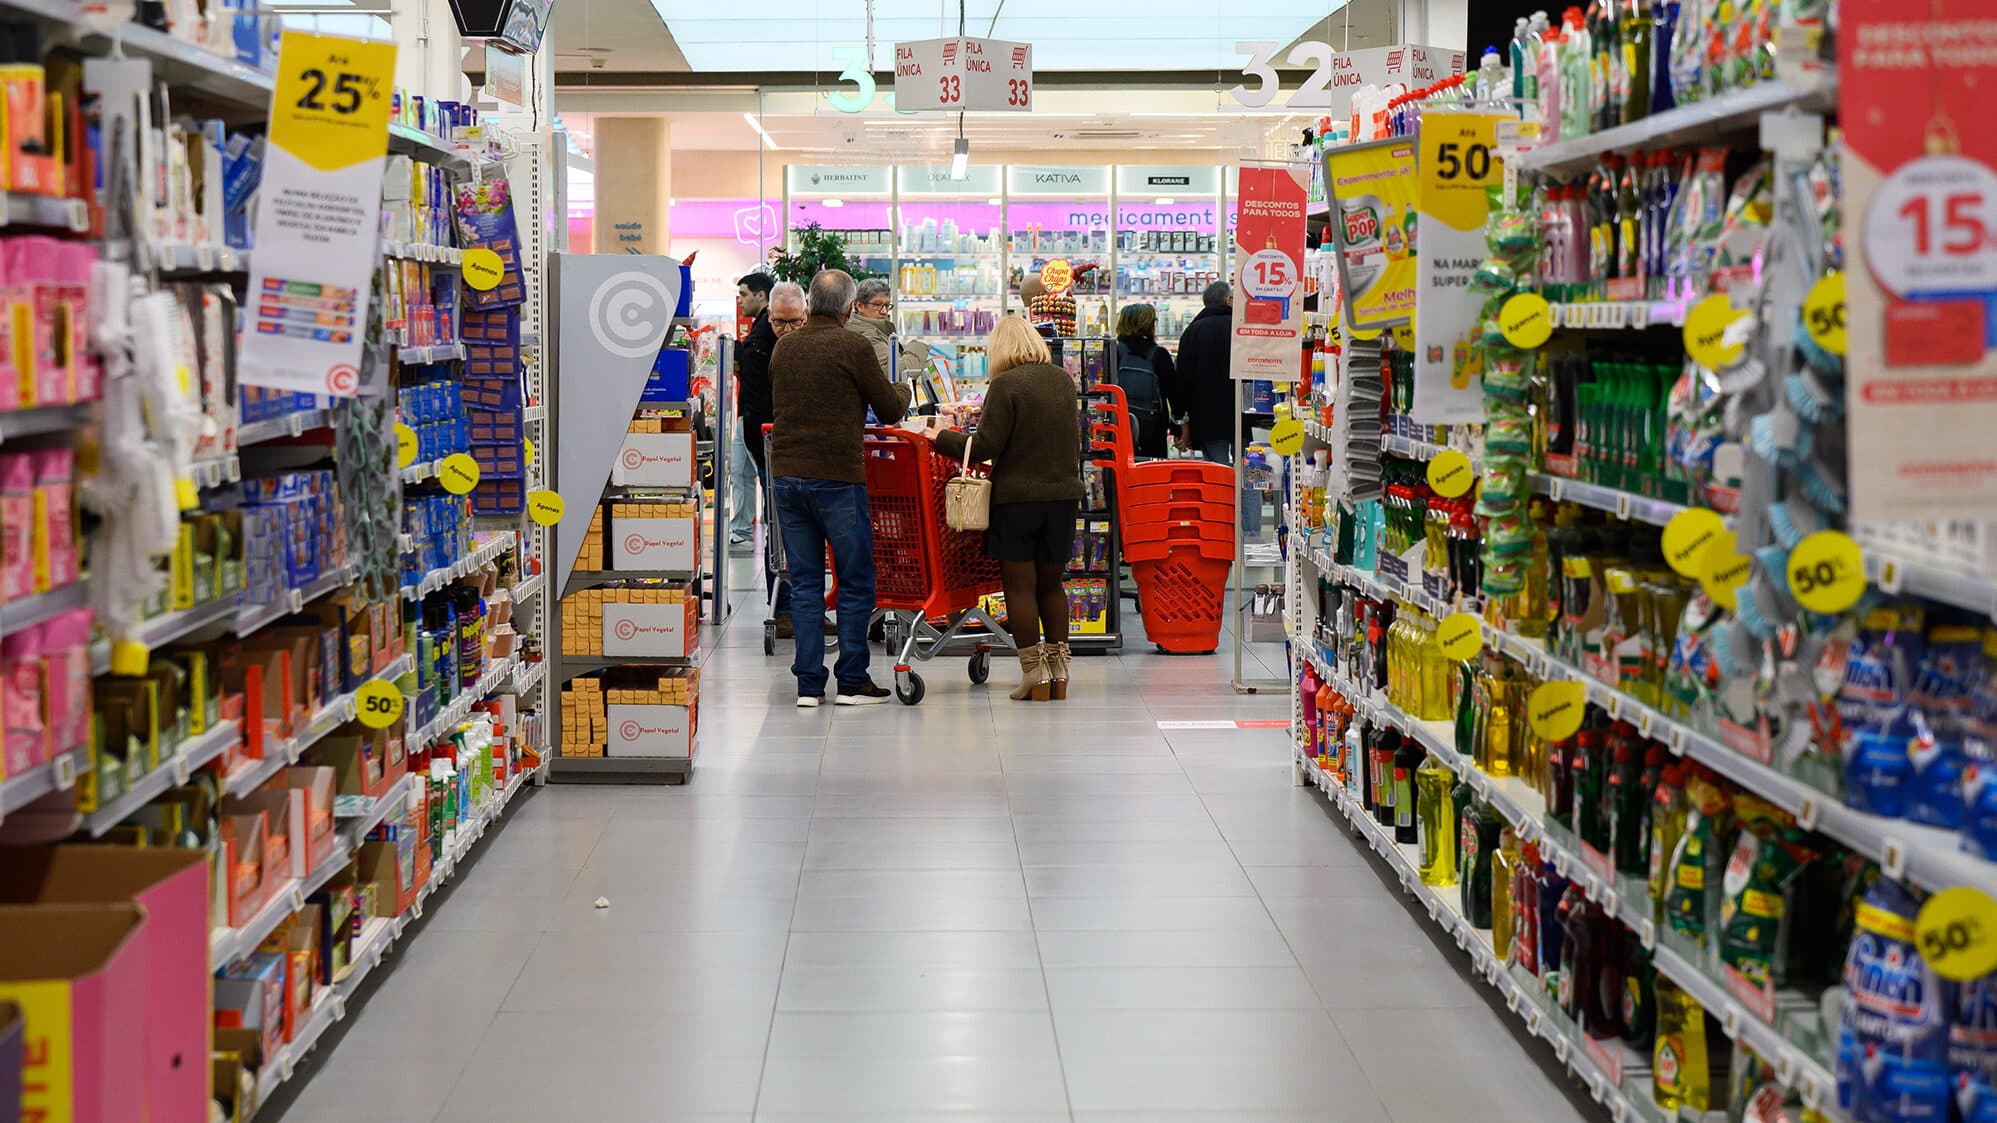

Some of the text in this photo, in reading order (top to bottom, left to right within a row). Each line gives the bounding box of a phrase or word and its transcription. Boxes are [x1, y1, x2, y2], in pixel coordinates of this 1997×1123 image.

[896, 48, 913, 60] FILA
[966, 42, 983, 55] FILA
[1412, 49, 1427, 62] FILA
[896, 62, 921, 77] ÚNICA
[966, 56, 991, 72] ÚNICA
[1333, 57, 1353, 70] FILA
[1230, 41, 1333, 108] 32
[1412, 64, 1435, 81] ÚNICA
[1333, 72, 1362, 87] ÚNICA
[939, 75, 961, 103] 33
[1008, 79, 1029, 107] 33
[1459, 128, 1476, 138] Até
[824, 174, 867, 182] HERBATINT
[928, 174, 970, 182] OLAX
[1036, 173, 1081, 184] KATIVA
[1152, 177, 1186, 185] KLORANE
[1245, 200, 1299, 209] DESCONTOS
[1069, 208, 1237, 226] meicaments
[1243, 208, 1301, 218] PARA TODOS
[1345, 210, 1369, 225] Super
[615, 221, 642, 230] saúde
[1349, 218, 1376, 241] POP
[620, 233, 642, 241] bebé
[470, 262, 498, 277] Apenas
[1433, 258, 1483, 270] NA MAR
[1254, 261, 1292, 285] 15%
[1432, 275, 1469, 288] SUPER
[1508, 311, 1541, 334] Apenas
[1276, 432, 1298, 444] Apenas
[642, 455, 659, 463] Papel
[660, 455, 681, 464] Vegetal
[449, 464, 474, 484] Apenas
[536, 502, 560, 514] Apenas
[662, 539, 684, 547] Vegetal
[652, 626, 674, 634] Vegetal
[657, 727, 679, 735] Vegetal
